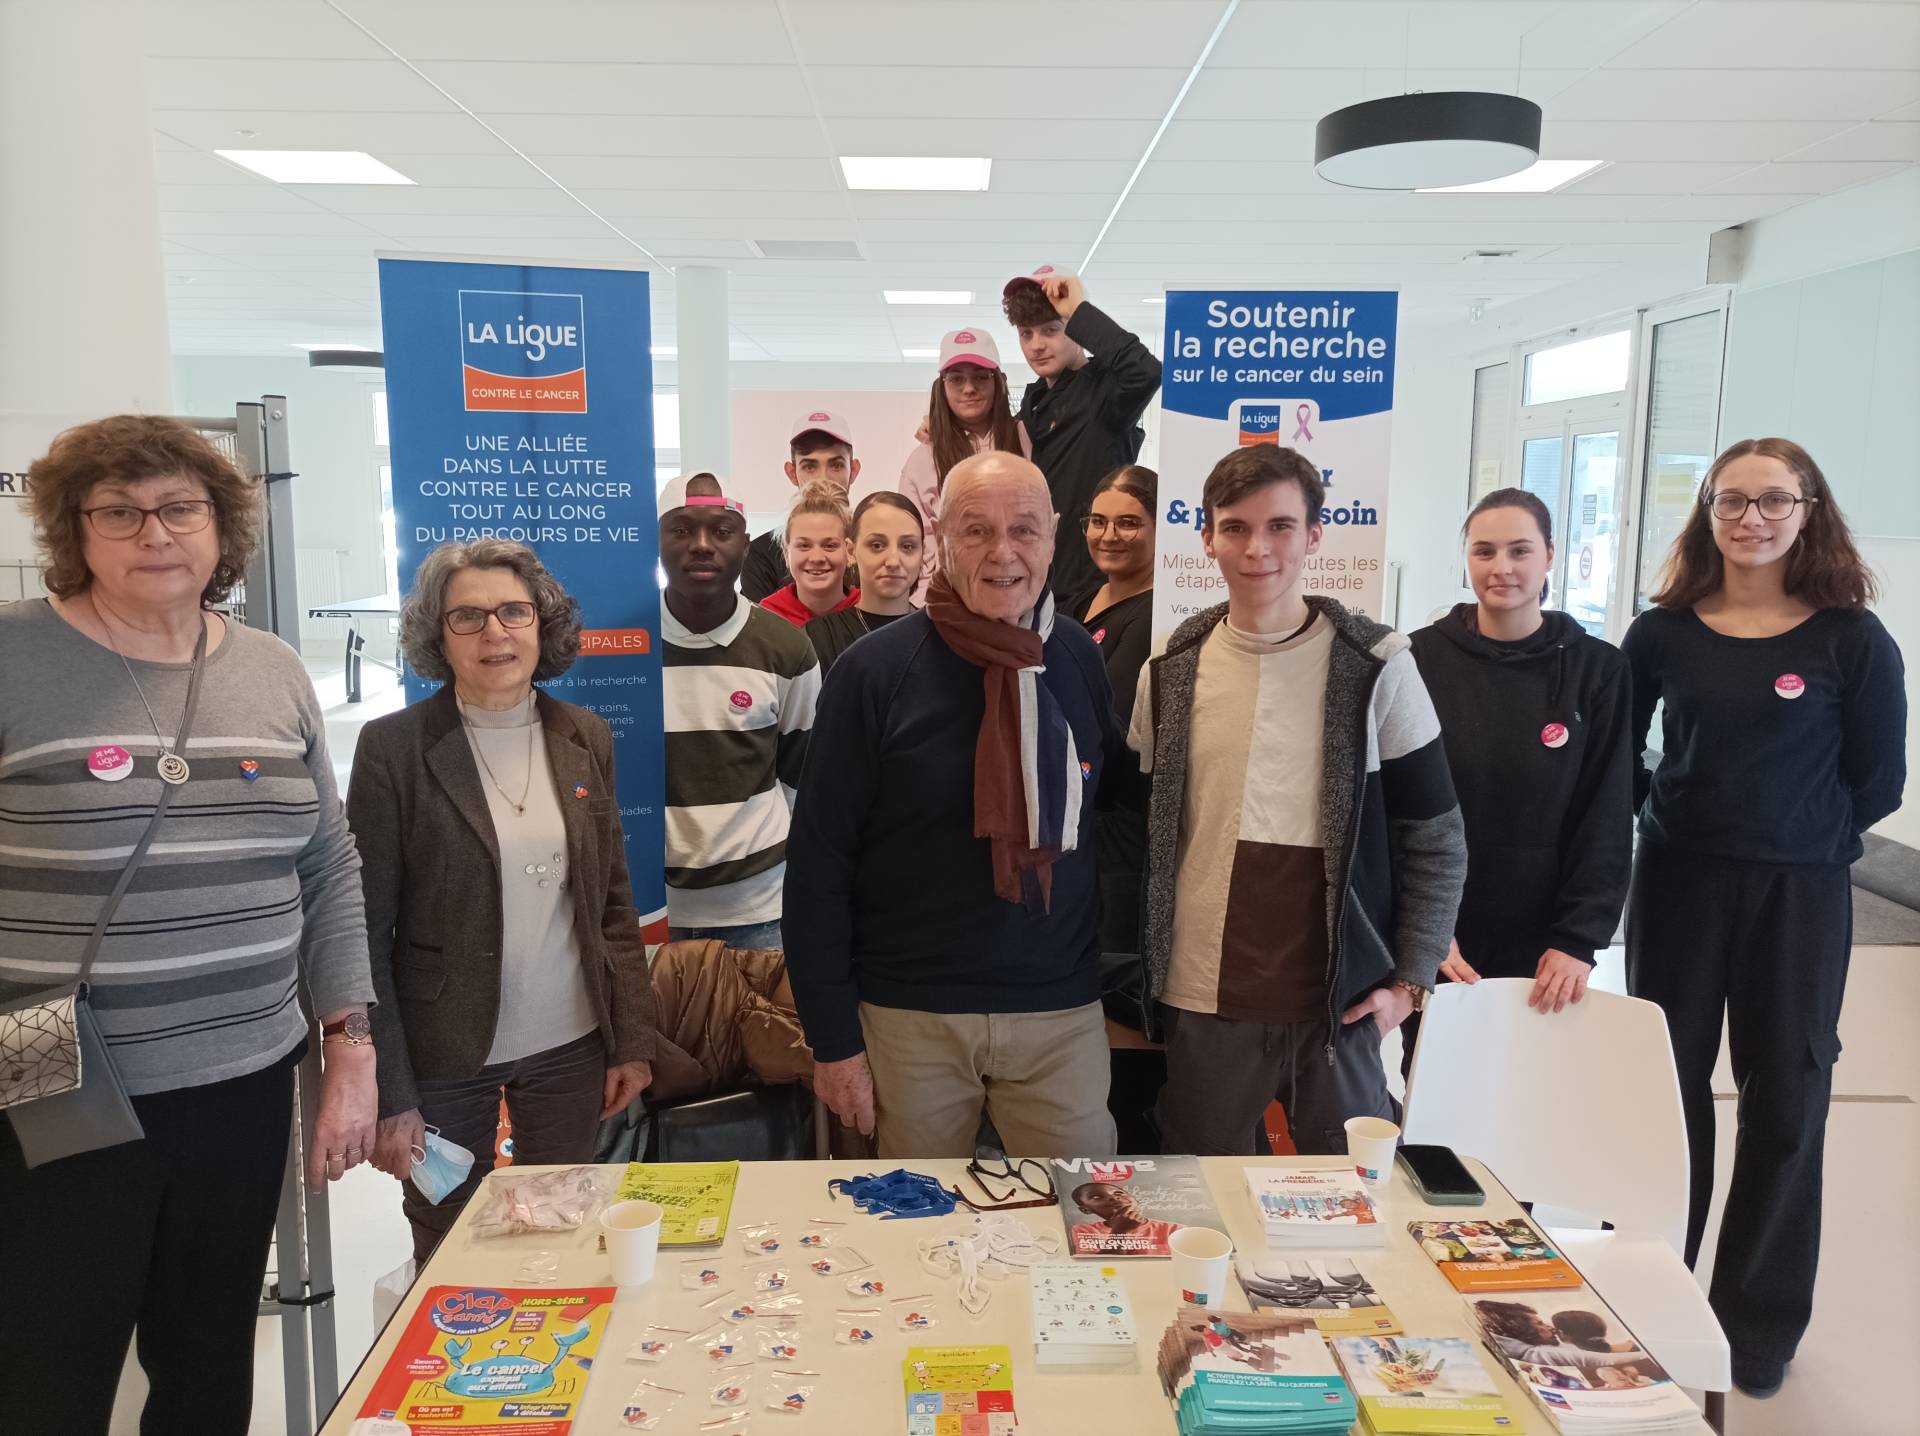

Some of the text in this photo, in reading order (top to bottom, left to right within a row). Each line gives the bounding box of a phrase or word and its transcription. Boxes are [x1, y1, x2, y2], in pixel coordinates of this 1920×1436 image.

[1207, 300, 1355, 328] Soutenir
[468, 322, 499, 344] LA
[1173, 330, 1386, 359] la recherche
[1172, 366, 1384, 384] sur le cancer du sein
[471, 388, 580, 401] CONTRE LE CANCER
[1241, 415, 1252, 424] LA
[466, 432, 588, 452] UNE ALLIÉE
[443, 458, 607, 475] DANS LA LUTTE
[420, 480, 631, 498] CONTRE LE CANCER
[449, 504, 606, 520] TOUT AU LONG
[416, 526, 640, 543] DU PARCOURS DE VIE
[1163, 553, 1216, 570] Mieux
[1353, 556, 1378, 571] les
[1175, 571, 1227, 592] étape
[1171, 604, 1189, 615] Vie
[579, 636, 642, 649] CIPALES
[566, 677, 574, 687] à
[577, 676, 587, 687] la
[590, 674, 647, 687] recherche
[617, 804, 652, 816] alades
[1052, 1157, 1156, 1174] Vivre
[437, 1292, 515, 1314] Clap
[460, 1363, 549, 1376] Le cancer
